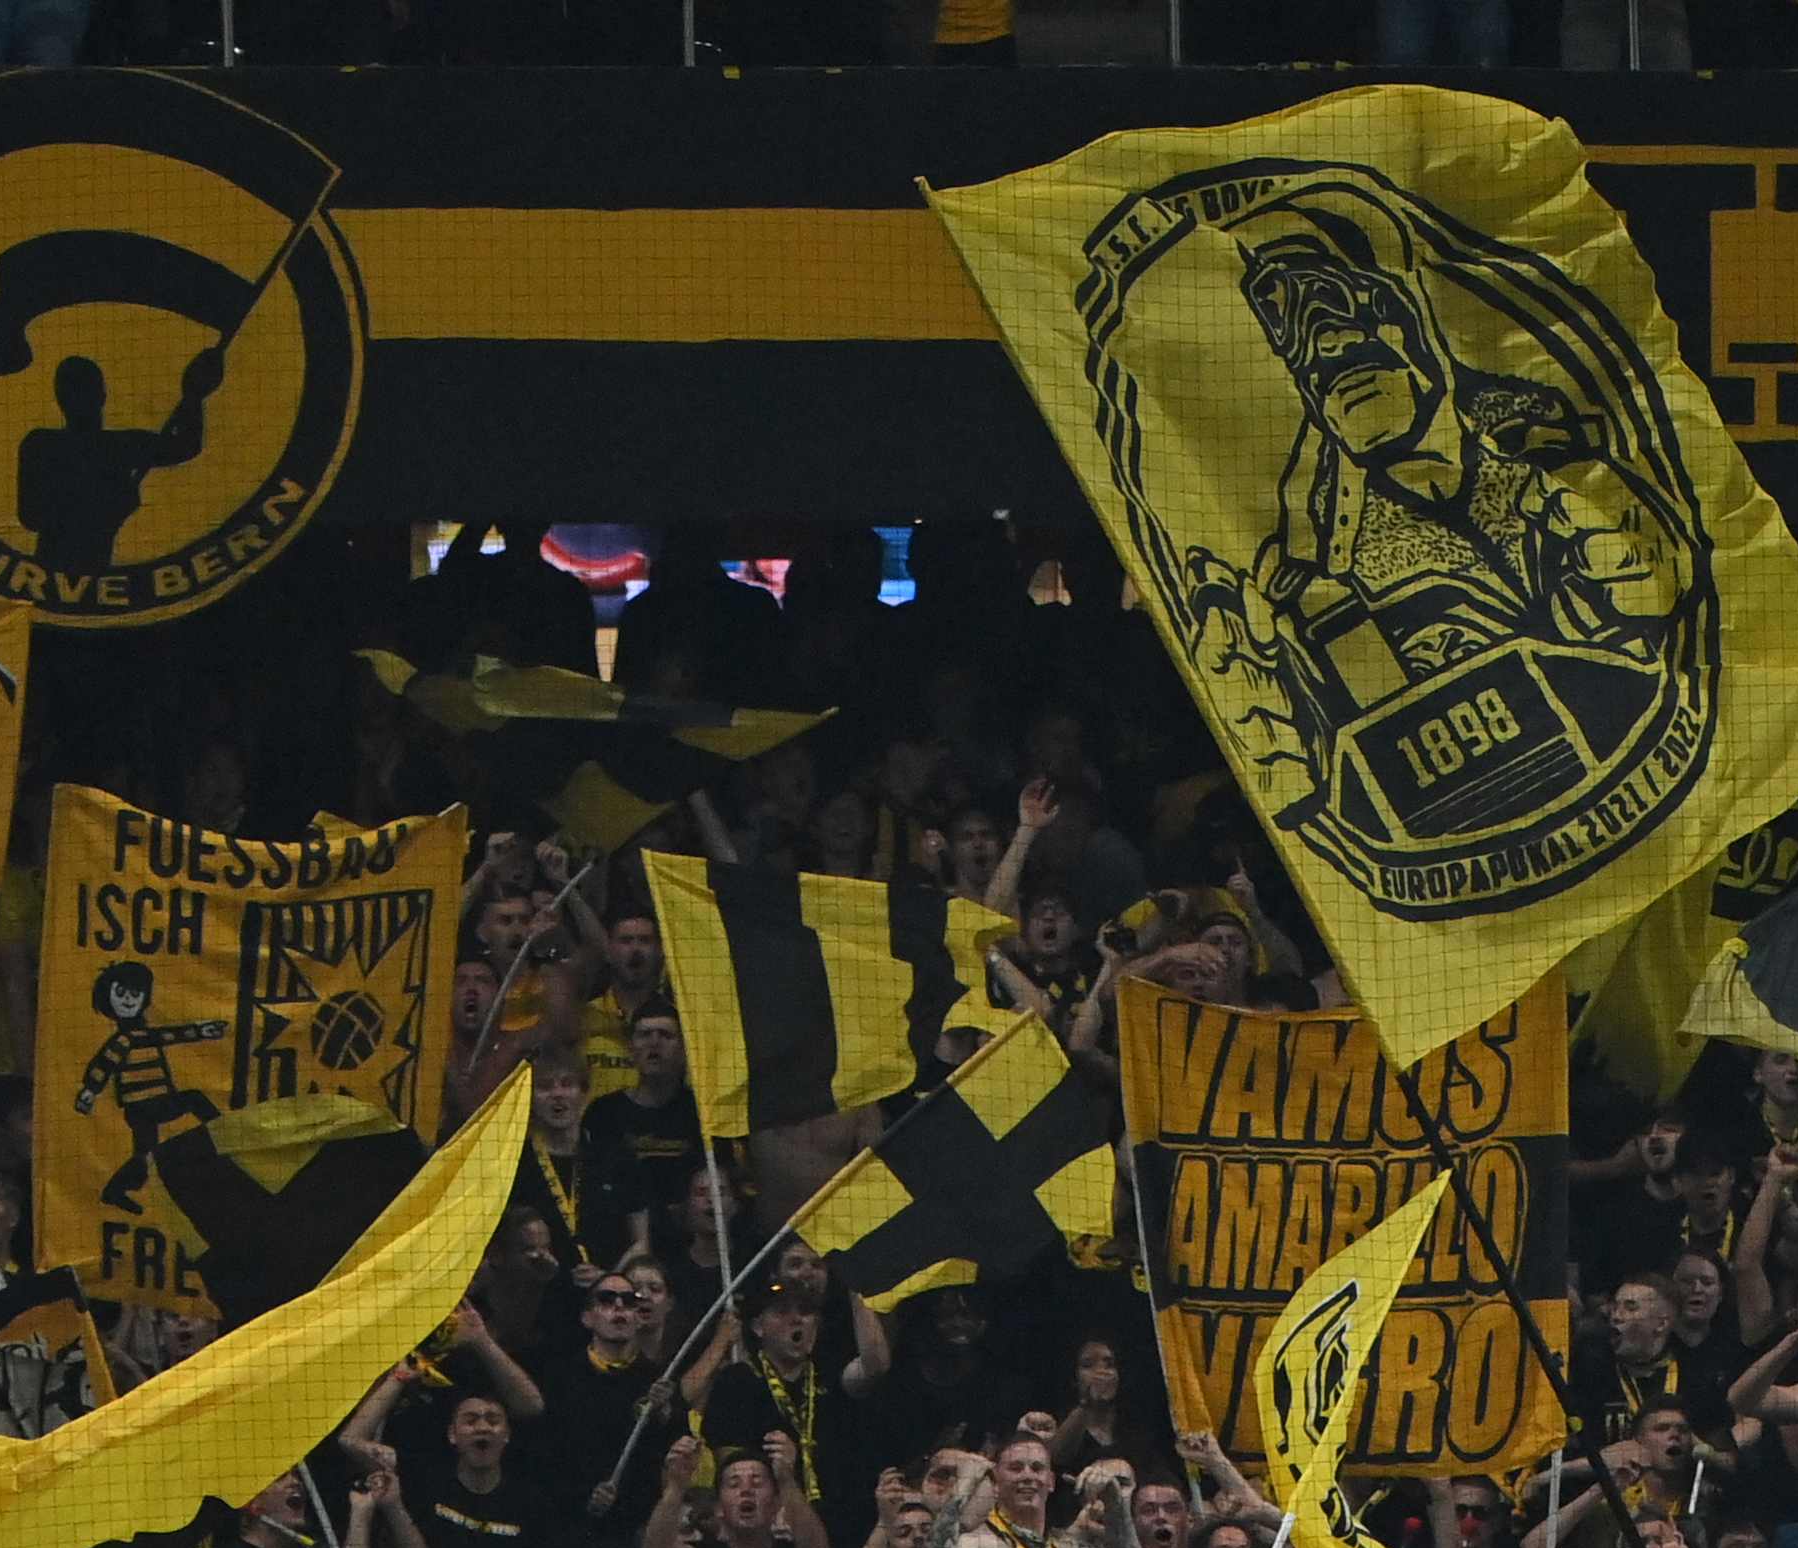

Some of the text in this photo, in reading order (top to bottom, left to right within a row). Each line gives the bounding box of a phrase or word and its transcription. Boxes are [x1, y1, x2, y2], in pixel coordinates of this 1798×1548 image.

[152, 476, 306, 598] BERN
[1397, 687, 1522, 789] 1898
[1578, 777, 1649, 846] 2021
[1653, 706, 1702, 780] 2022
[75, 886, 205, 956] ISCH
